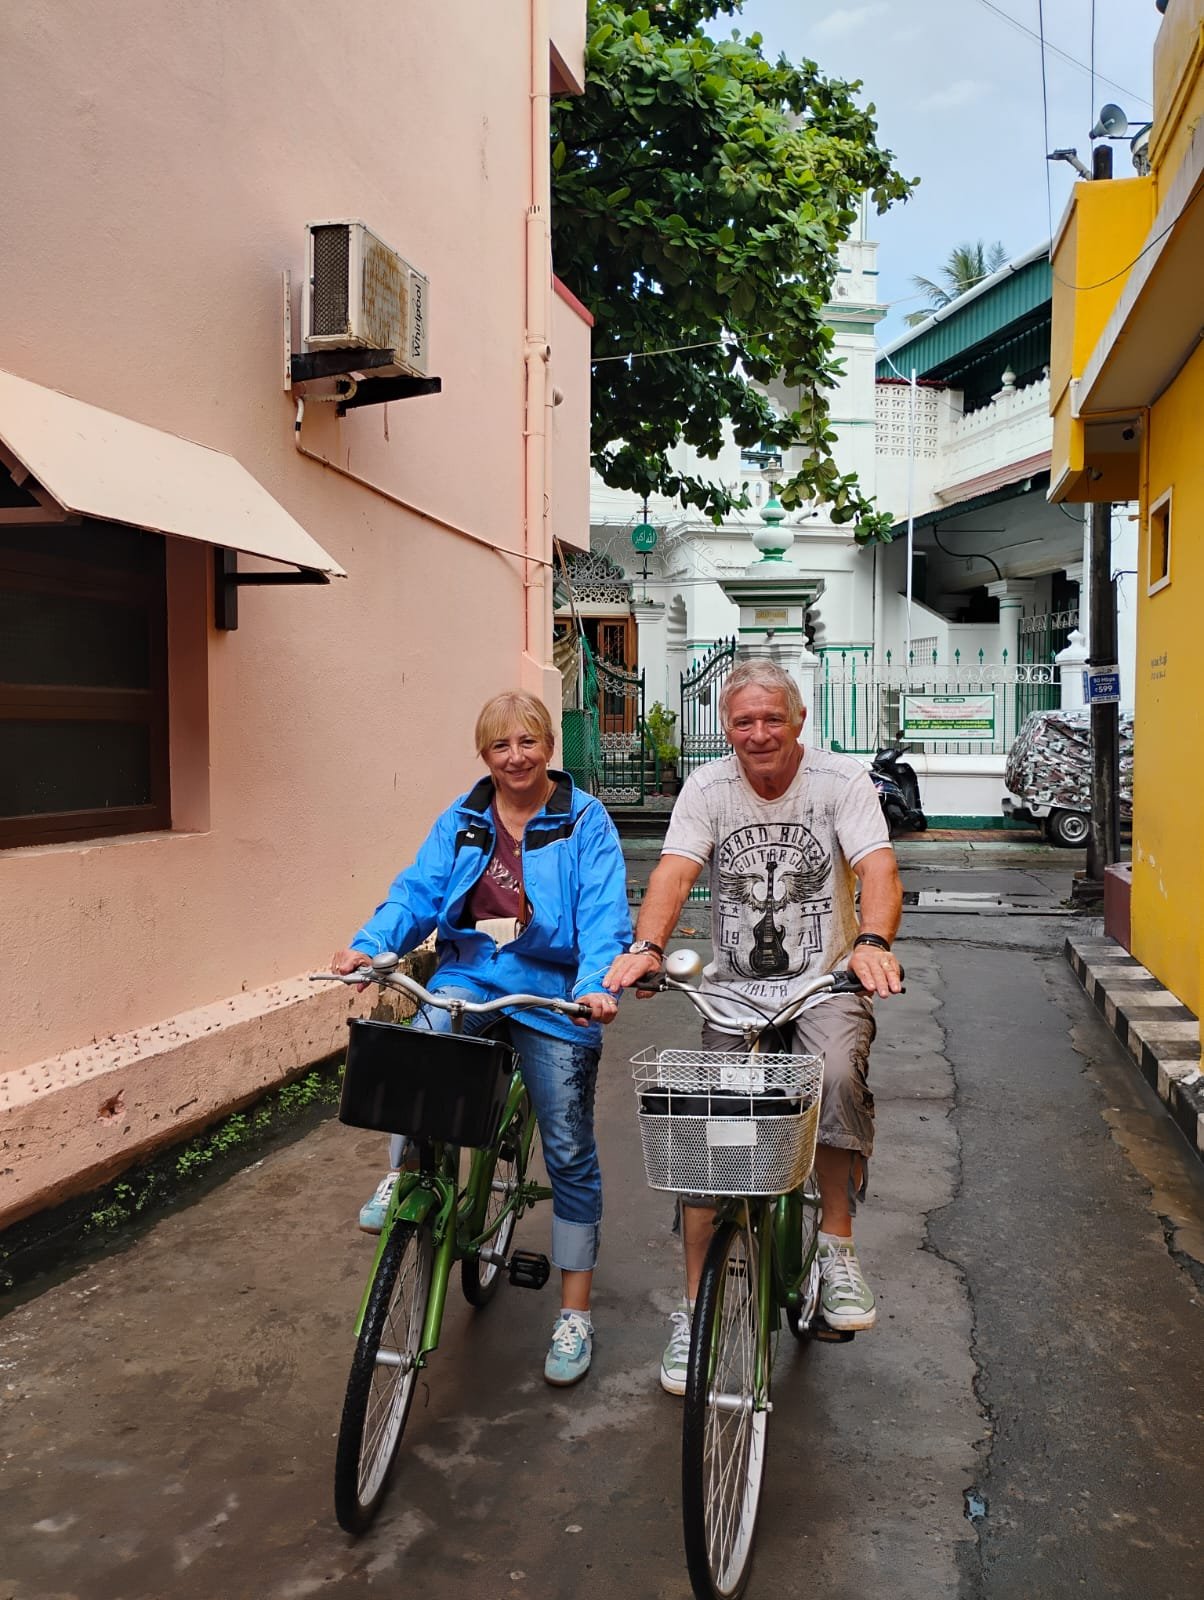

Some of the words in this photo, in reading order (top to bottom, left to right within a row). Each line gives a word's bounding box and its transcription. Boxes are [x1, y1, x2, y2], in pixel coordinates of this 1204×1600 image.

[414, 283, 422, 357] Whirlpool
[723, 827, 768, 858] HARD
[779, 827, 816, 856] ROCK
[735, 848, 787, 873] GUITAR
[725, 930, 740, 945] 19
[797, 930, 813, 947] 71
[740, 982, 788, 998] MALTA
